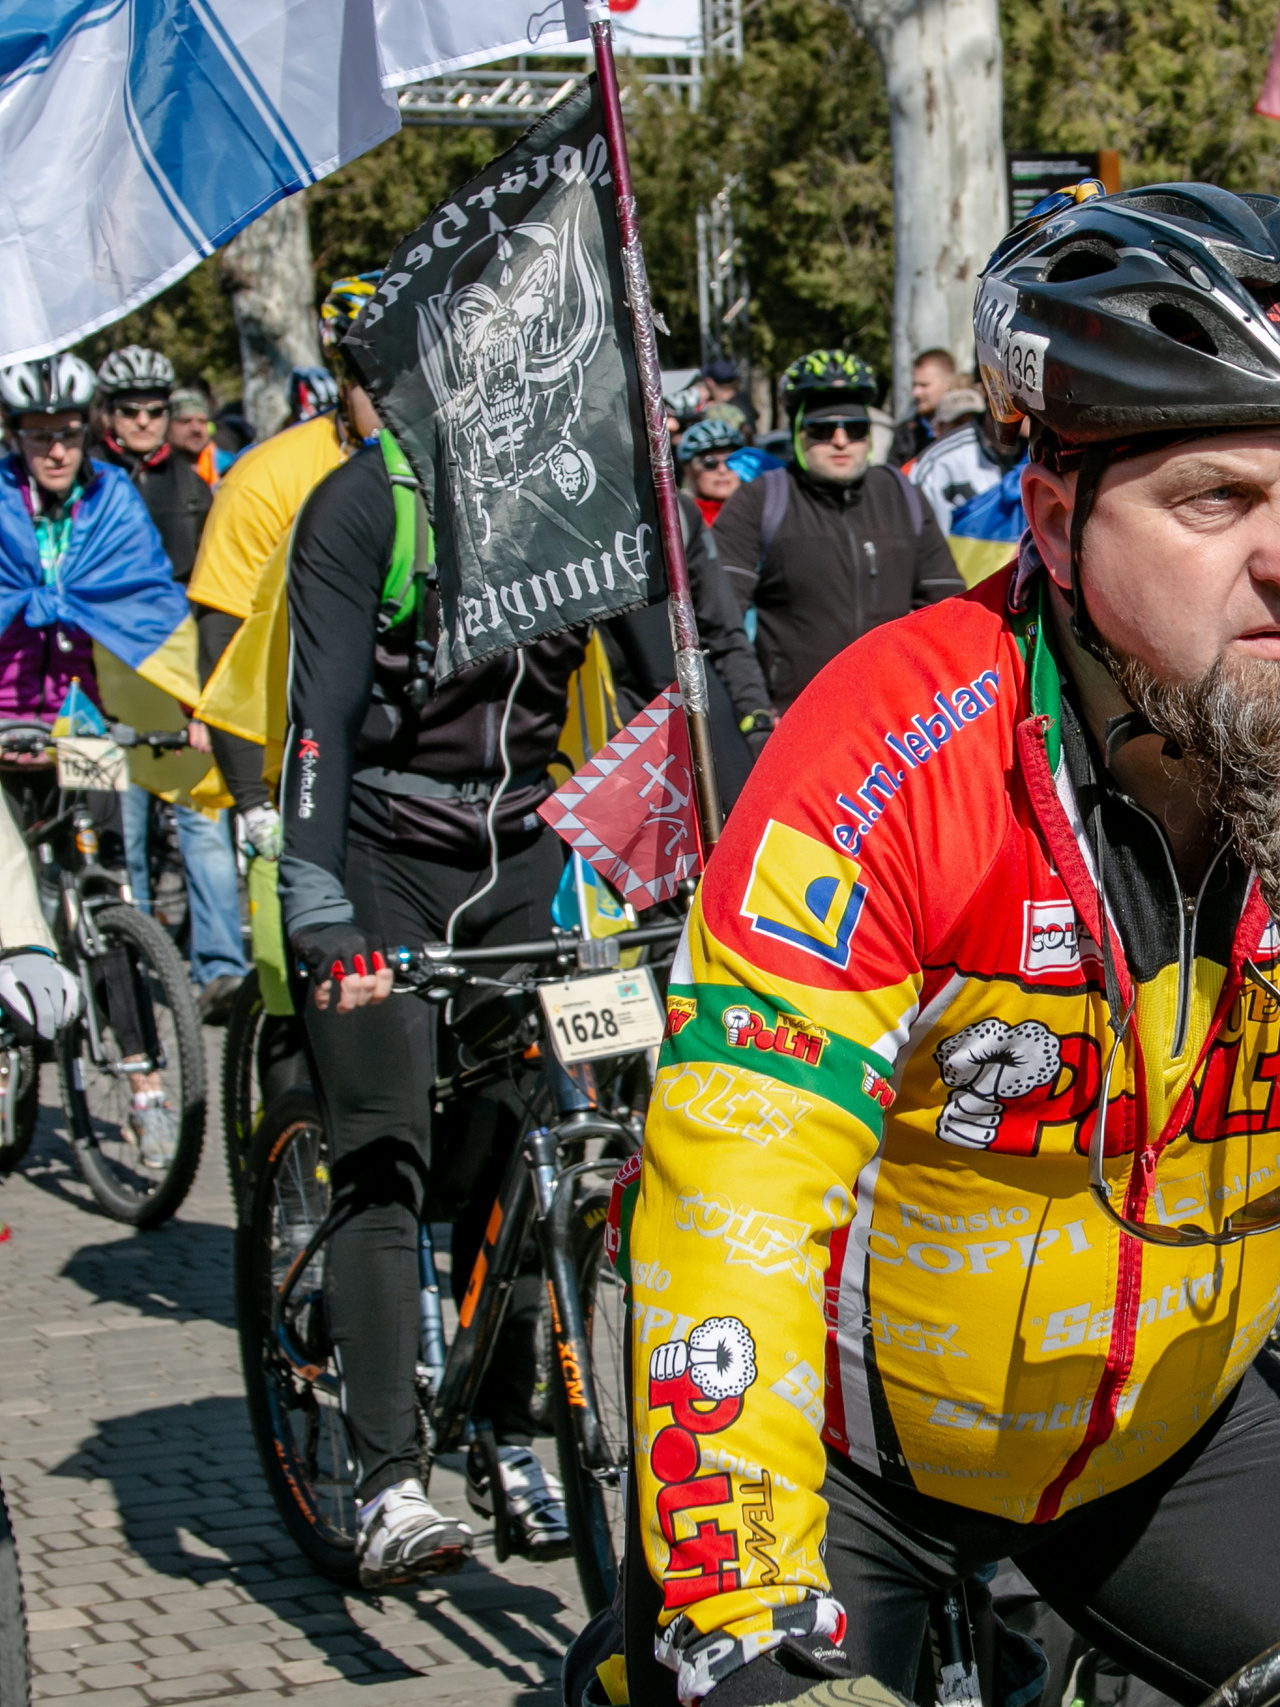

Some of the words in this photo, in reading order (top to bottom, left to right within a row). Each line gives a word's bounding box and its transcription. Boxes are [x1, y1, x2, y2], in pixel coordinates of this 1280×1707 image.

[1003, 341, 1037, 393] 136
[556, 1007, 619, 1046] 1628
[900, 1204, 1031, 1234] Fausto
[856, 1218, 1093, 1275] COPPI
[1040, 1258, 1227, 1353] Santini
